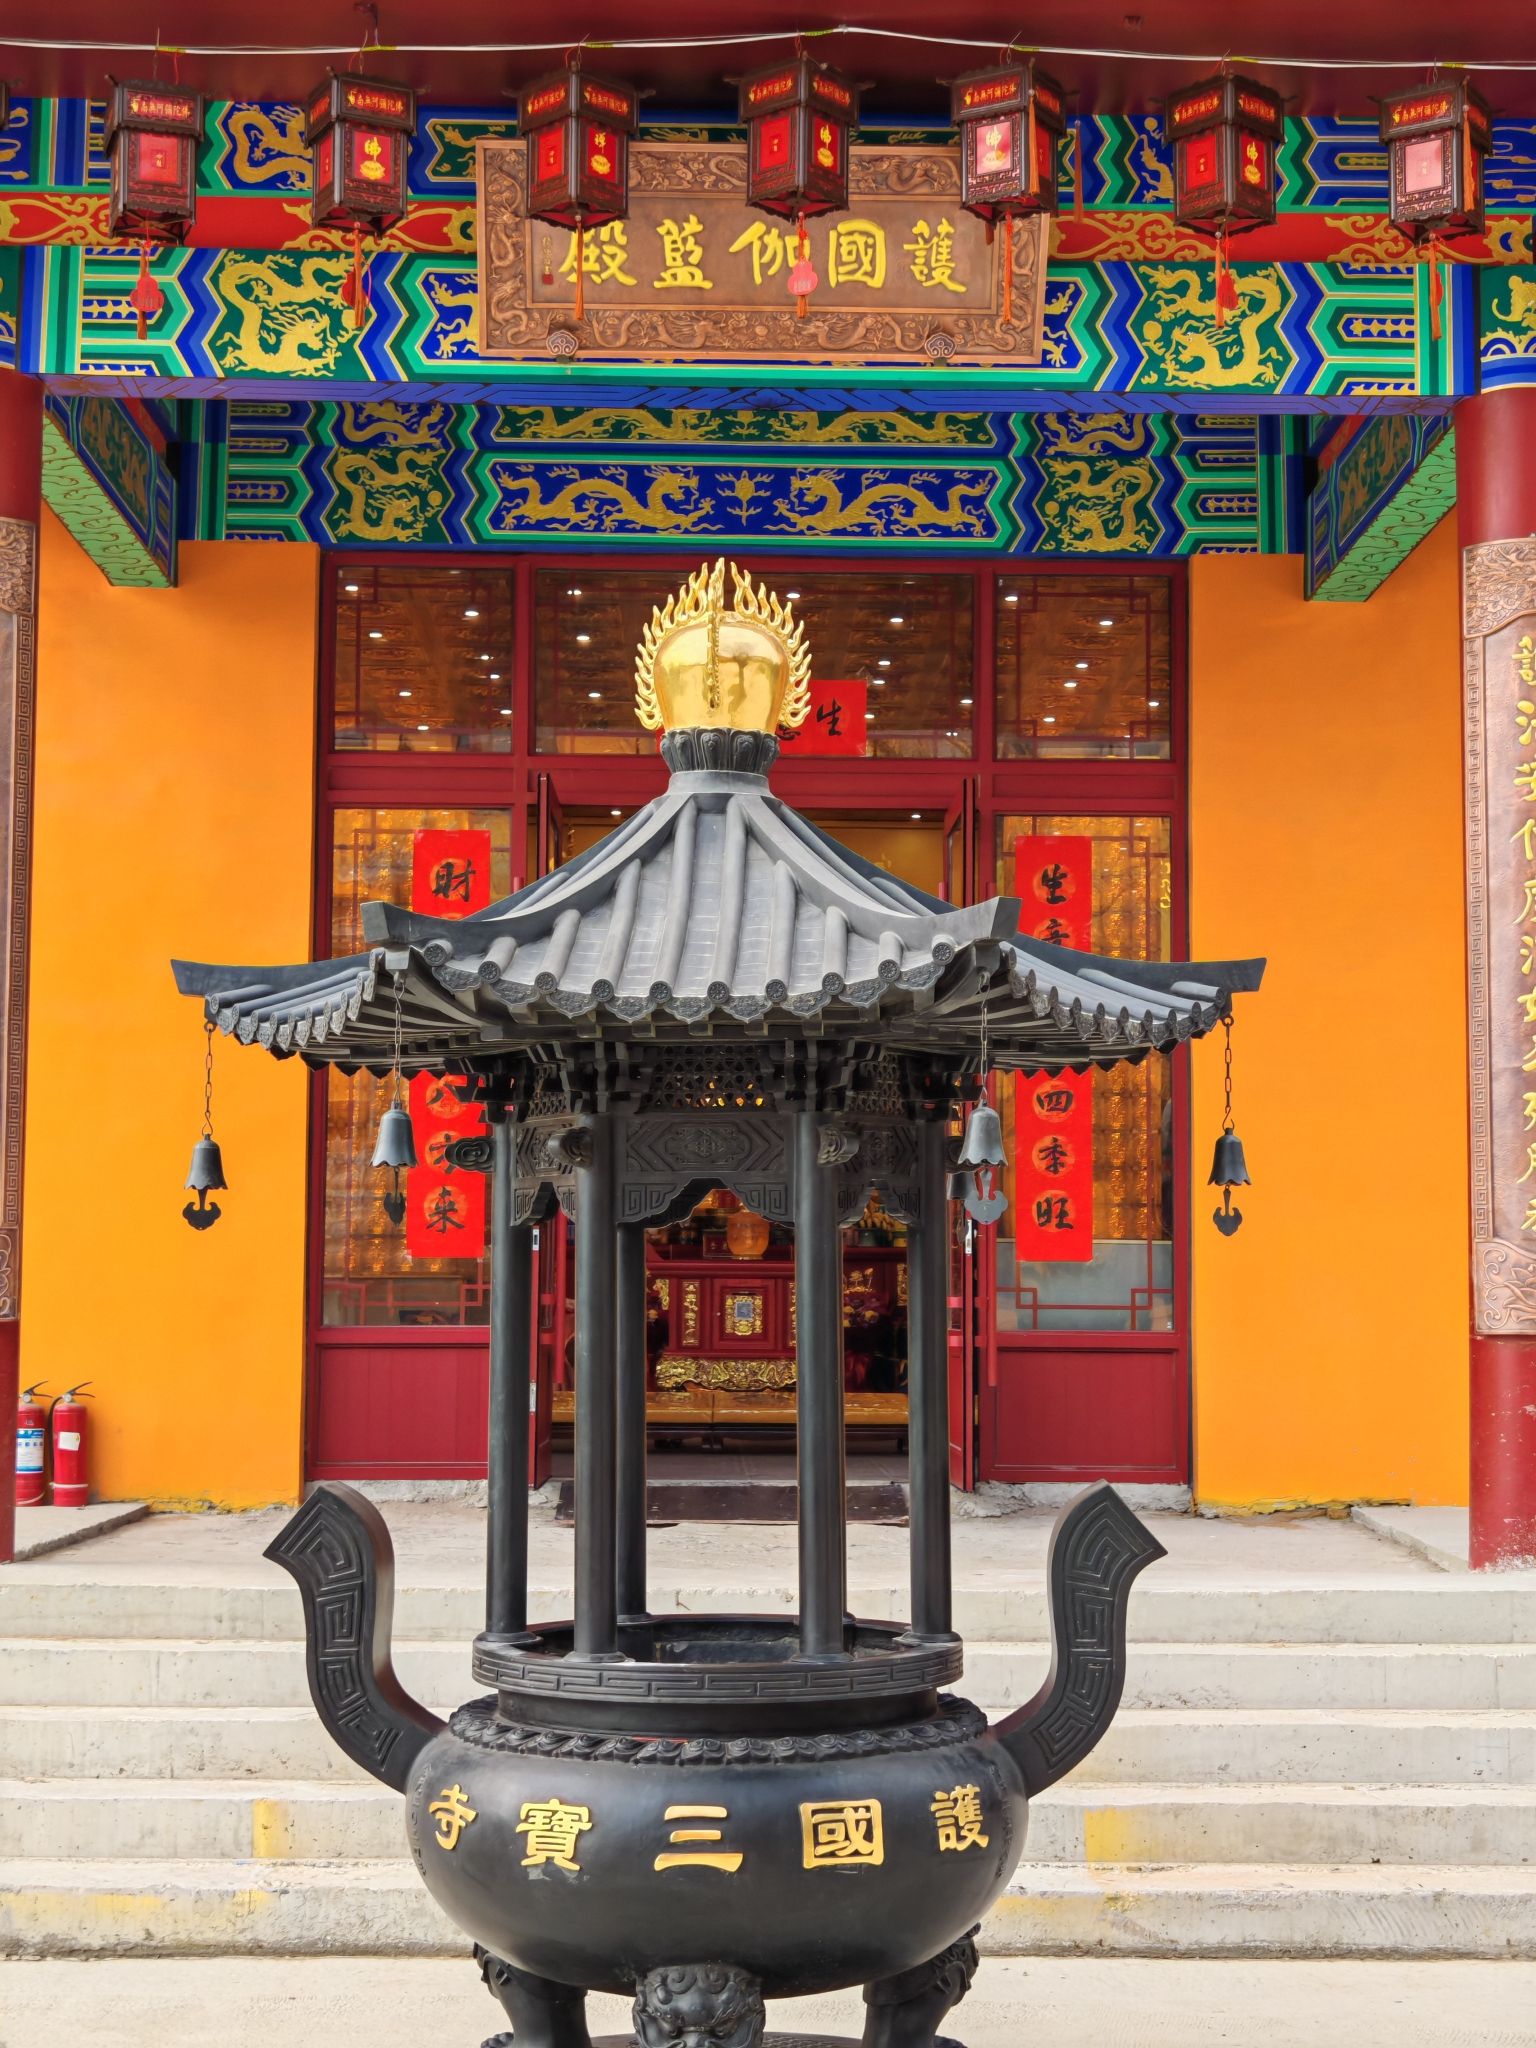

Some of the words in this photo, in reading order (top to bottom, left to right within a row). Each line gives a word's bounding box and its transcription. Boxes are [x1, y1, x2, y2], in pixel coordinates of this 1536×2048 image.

[1036, 1090, 1074, 1230] 四季旺
[428, 1783, 989, 1873] 護國三寶寺
